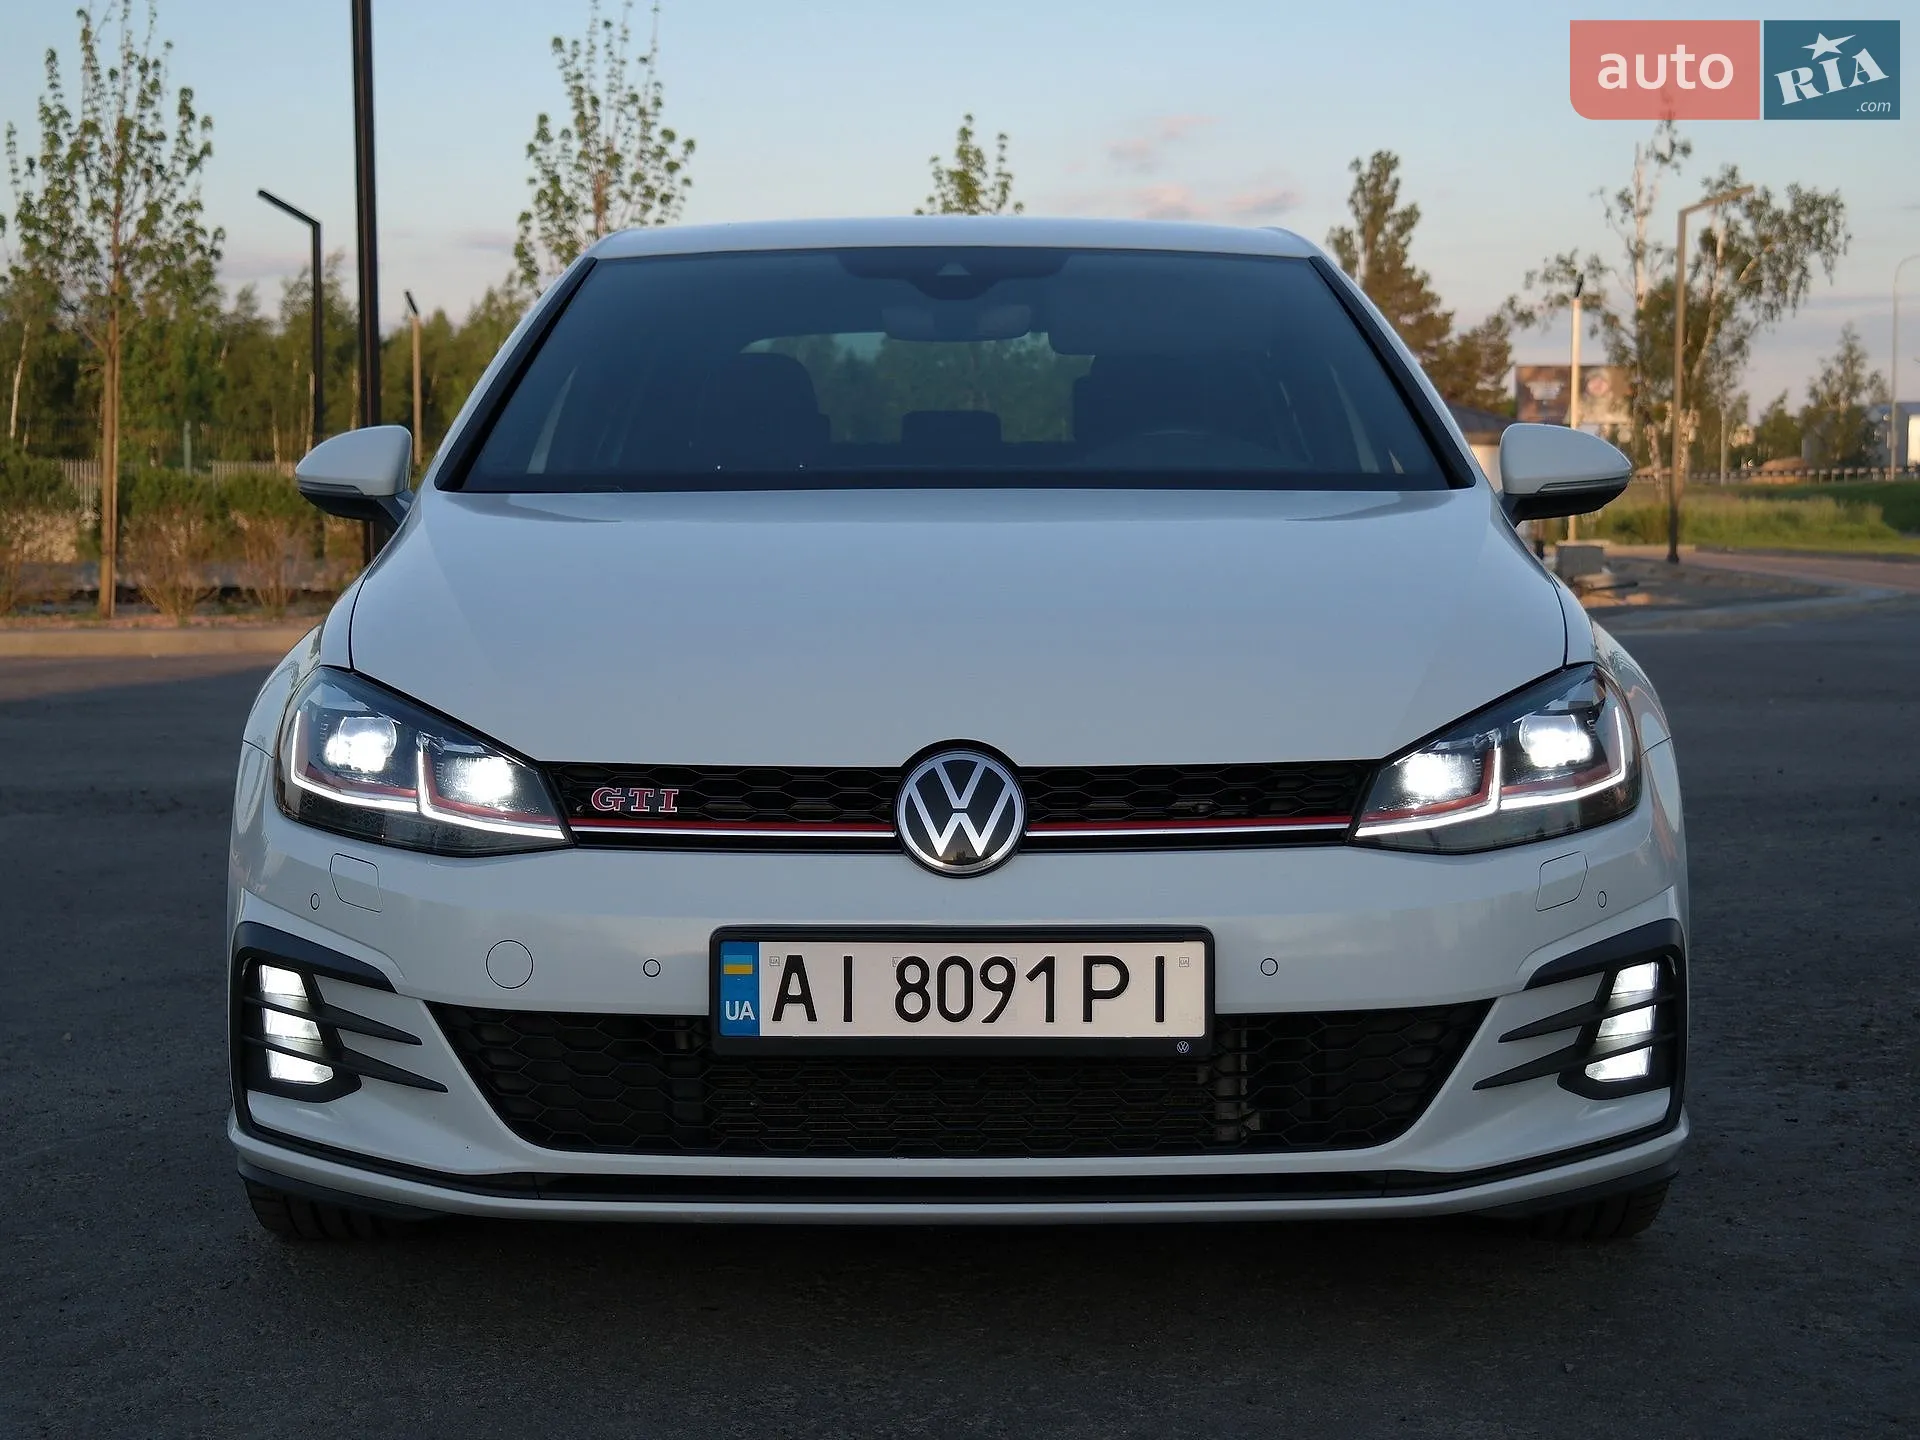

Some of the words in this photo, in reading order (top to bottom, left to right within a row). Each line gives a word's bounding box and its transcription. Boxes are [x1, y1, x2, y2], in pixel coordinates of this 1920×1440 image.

[591, 787, 680, 812] GTI
[771, 955, 854, 1022] AI
[895, 955, 1056, 1023] 8091
[1083, 955, 1165, 1022] PI
[725, 1000, 756, 1021] UA
